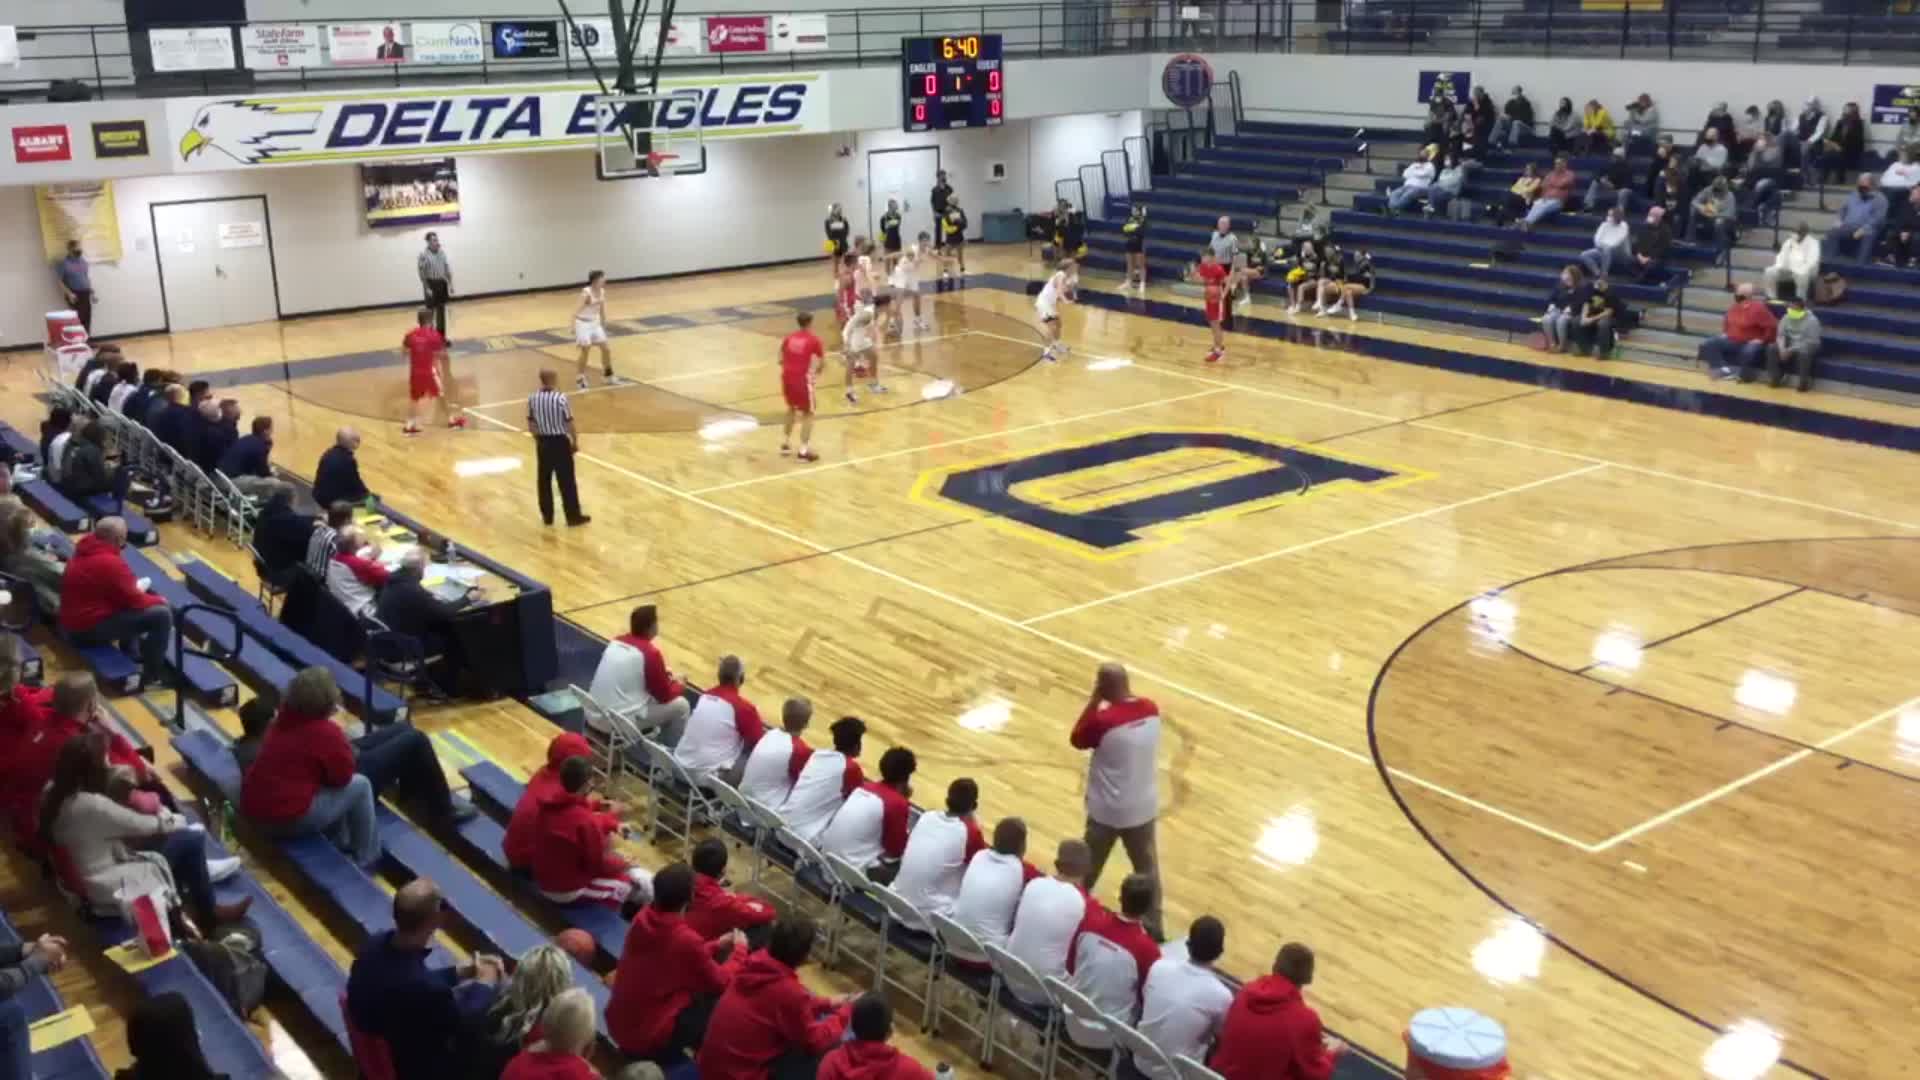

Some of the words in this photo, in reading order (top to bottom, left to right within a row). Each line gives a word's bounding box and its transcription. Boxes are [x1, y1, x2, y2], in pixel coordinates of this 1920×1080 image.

[943, 36, 978, 59] 6:40
[925, 74, 937, 95] 0
[989, 71, 1000, 91] 0
[915, 104, 925, 121] 0
[991, 100, 1000, 115] 0
[324, 96, 542, 149] DELTA
